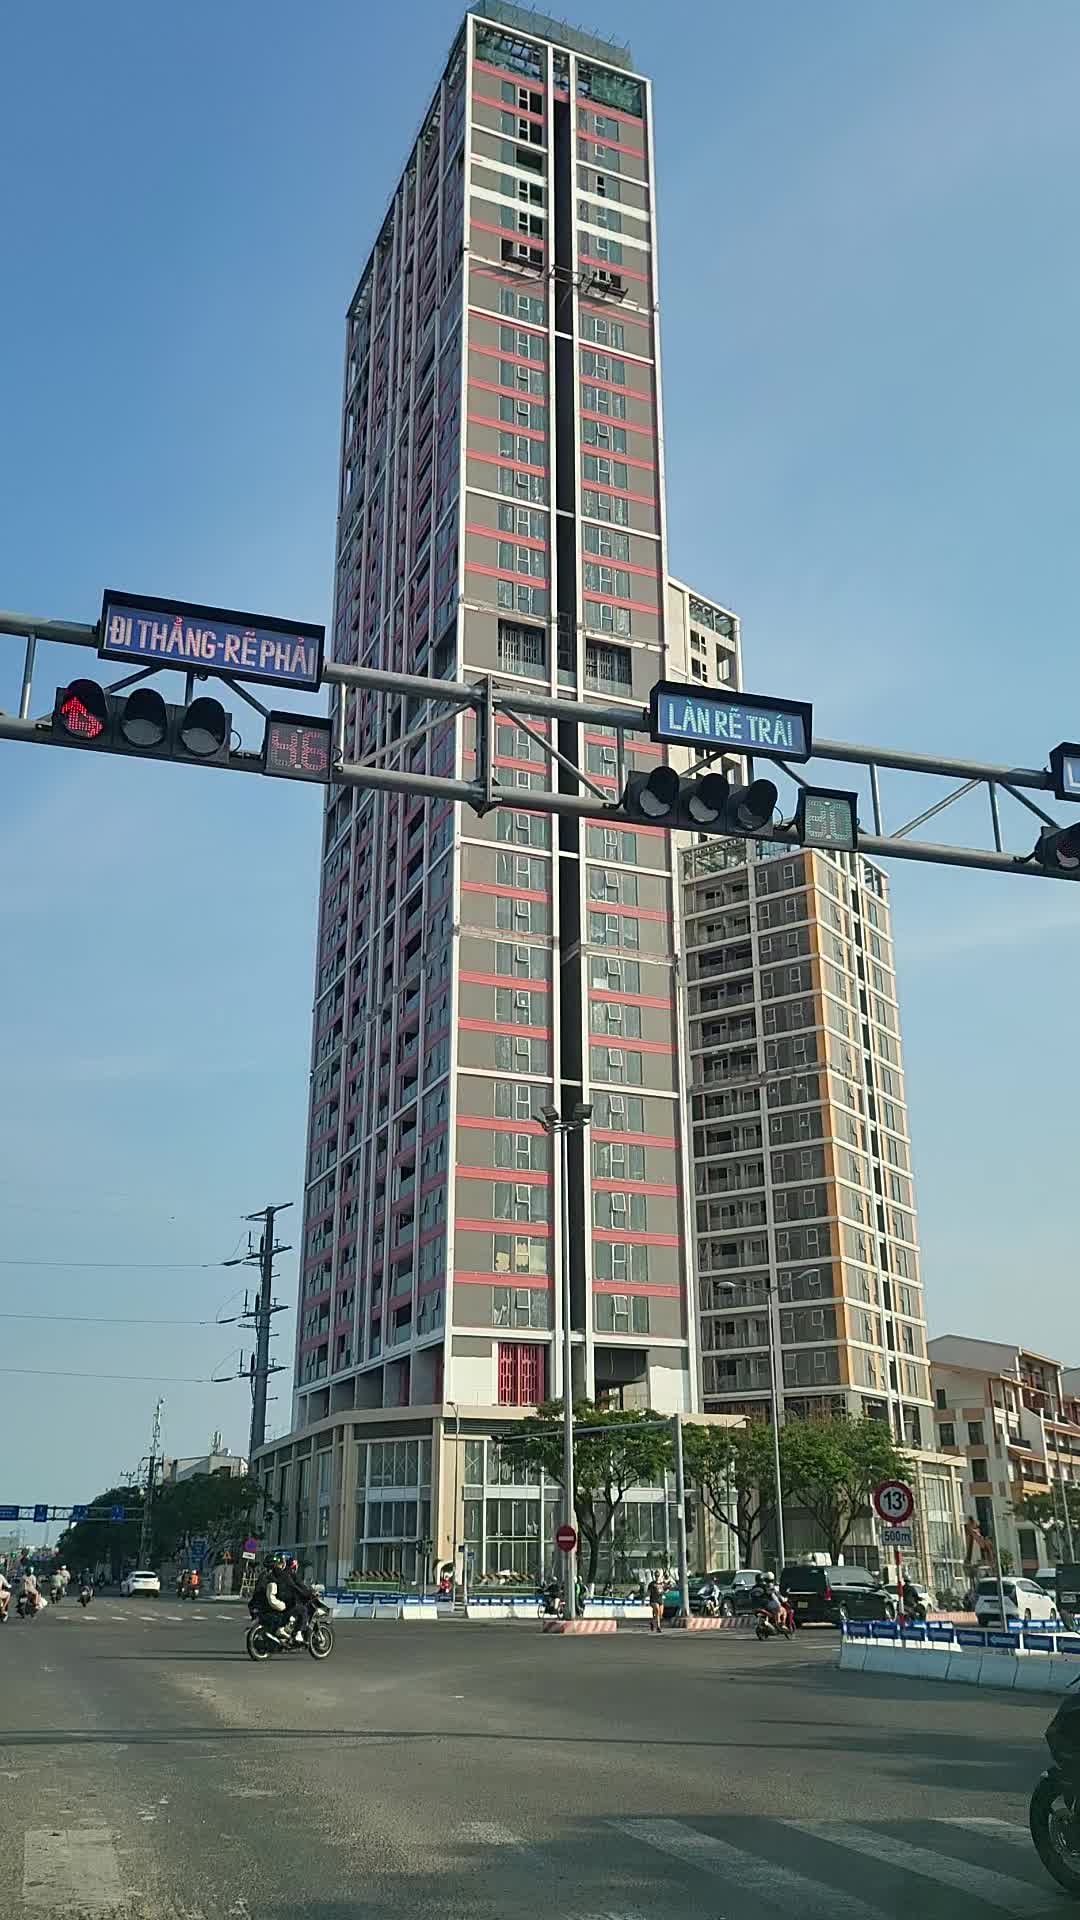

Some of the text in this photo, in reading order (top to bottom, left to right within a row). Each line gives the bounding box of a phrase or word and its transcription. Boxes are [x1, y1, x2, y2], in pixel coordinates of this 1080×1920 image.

[109, 615, 133, 646] ĐI
[668, 700, 793, 746] LÀN RẼ TRÁI
[884, 1530, 912, 1542] 500m
